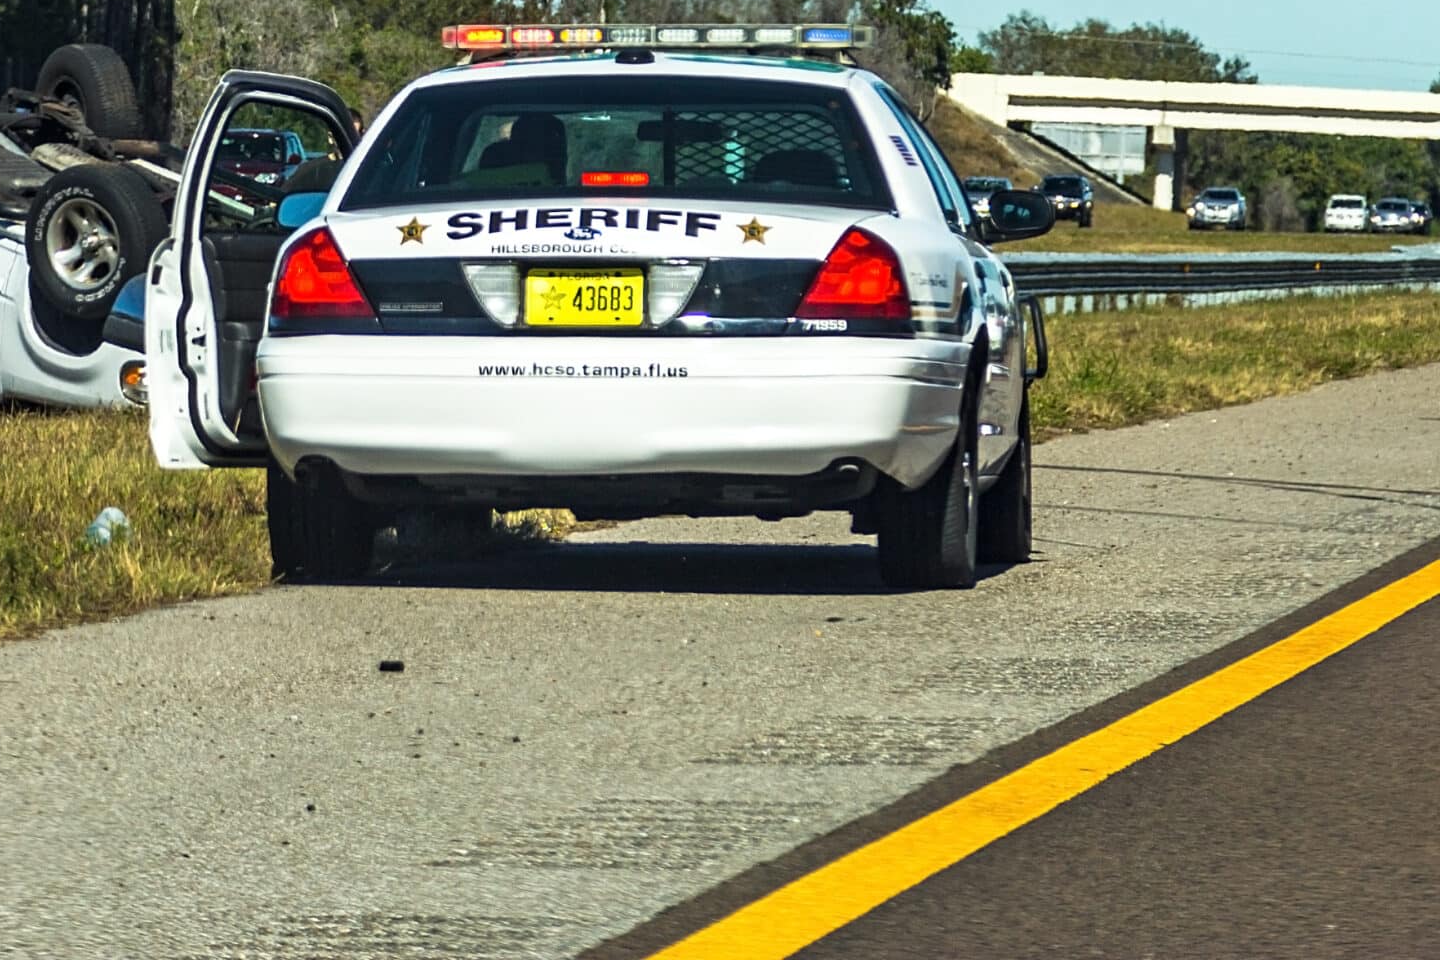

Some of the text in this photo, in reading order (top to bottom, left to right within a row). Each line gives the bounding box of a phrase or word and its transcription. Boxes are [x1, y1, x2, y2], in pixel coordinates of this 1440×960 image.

[447, 208, 722, 240] SHERIFF
[491, 244, 603, 254] HILLSBOROUGH
[573, 286, 633, 311] 43683
[478, 362, 689, 378] www.hcso.tampa.fl.us
